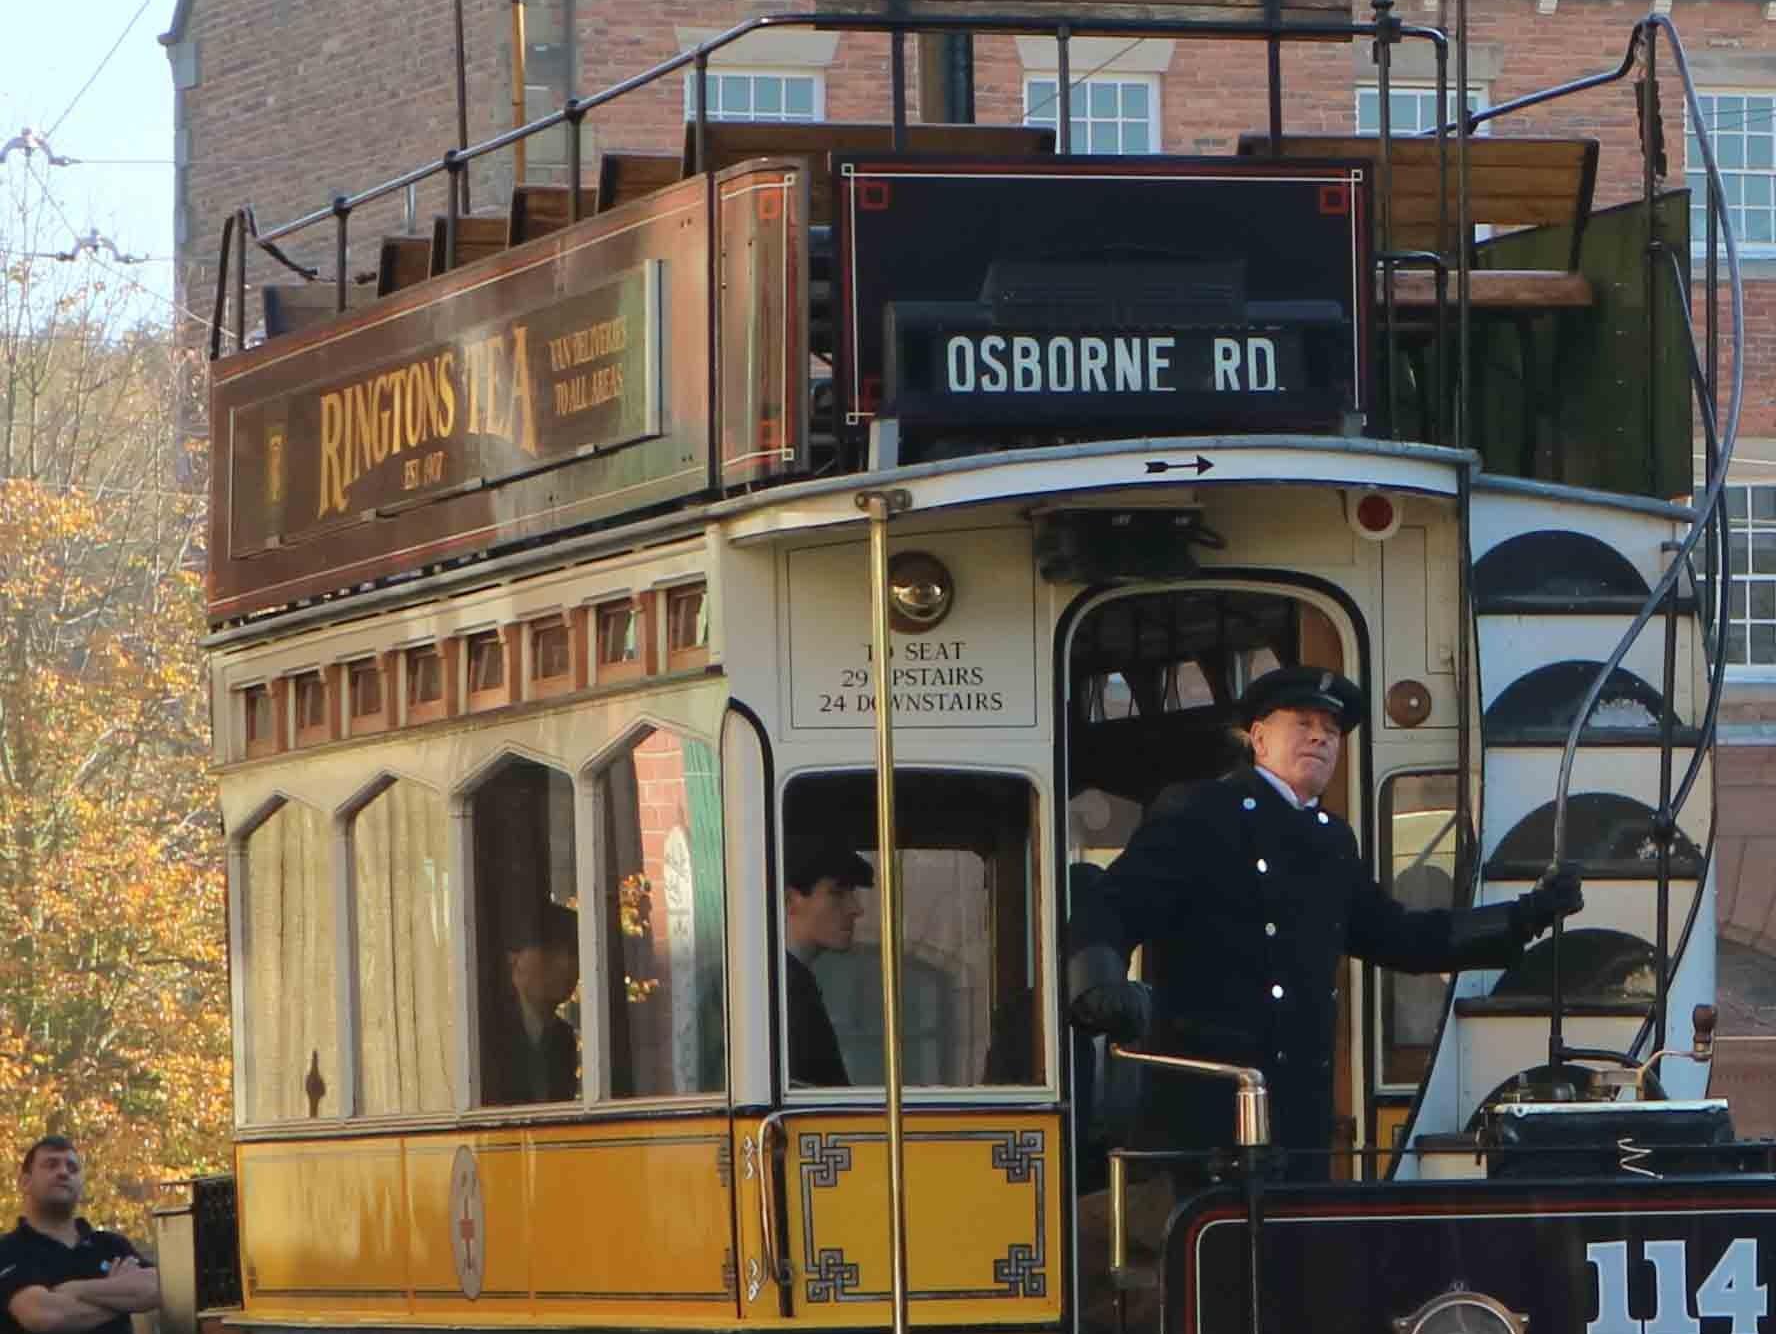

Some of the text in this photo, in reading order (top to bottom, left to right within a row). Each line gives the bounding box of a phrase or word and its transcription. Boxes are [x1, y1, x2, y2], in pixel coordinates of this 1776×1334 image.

[947, 335, 1286, 393] OSBORNE RD.
[318, 325, 538, 519] RINGTONS TEA
[905, 642, 967, 661] SEAT
[841, 666, 984, 687] 29 PSTAIRS
[819, 694, 847, 713] 24
